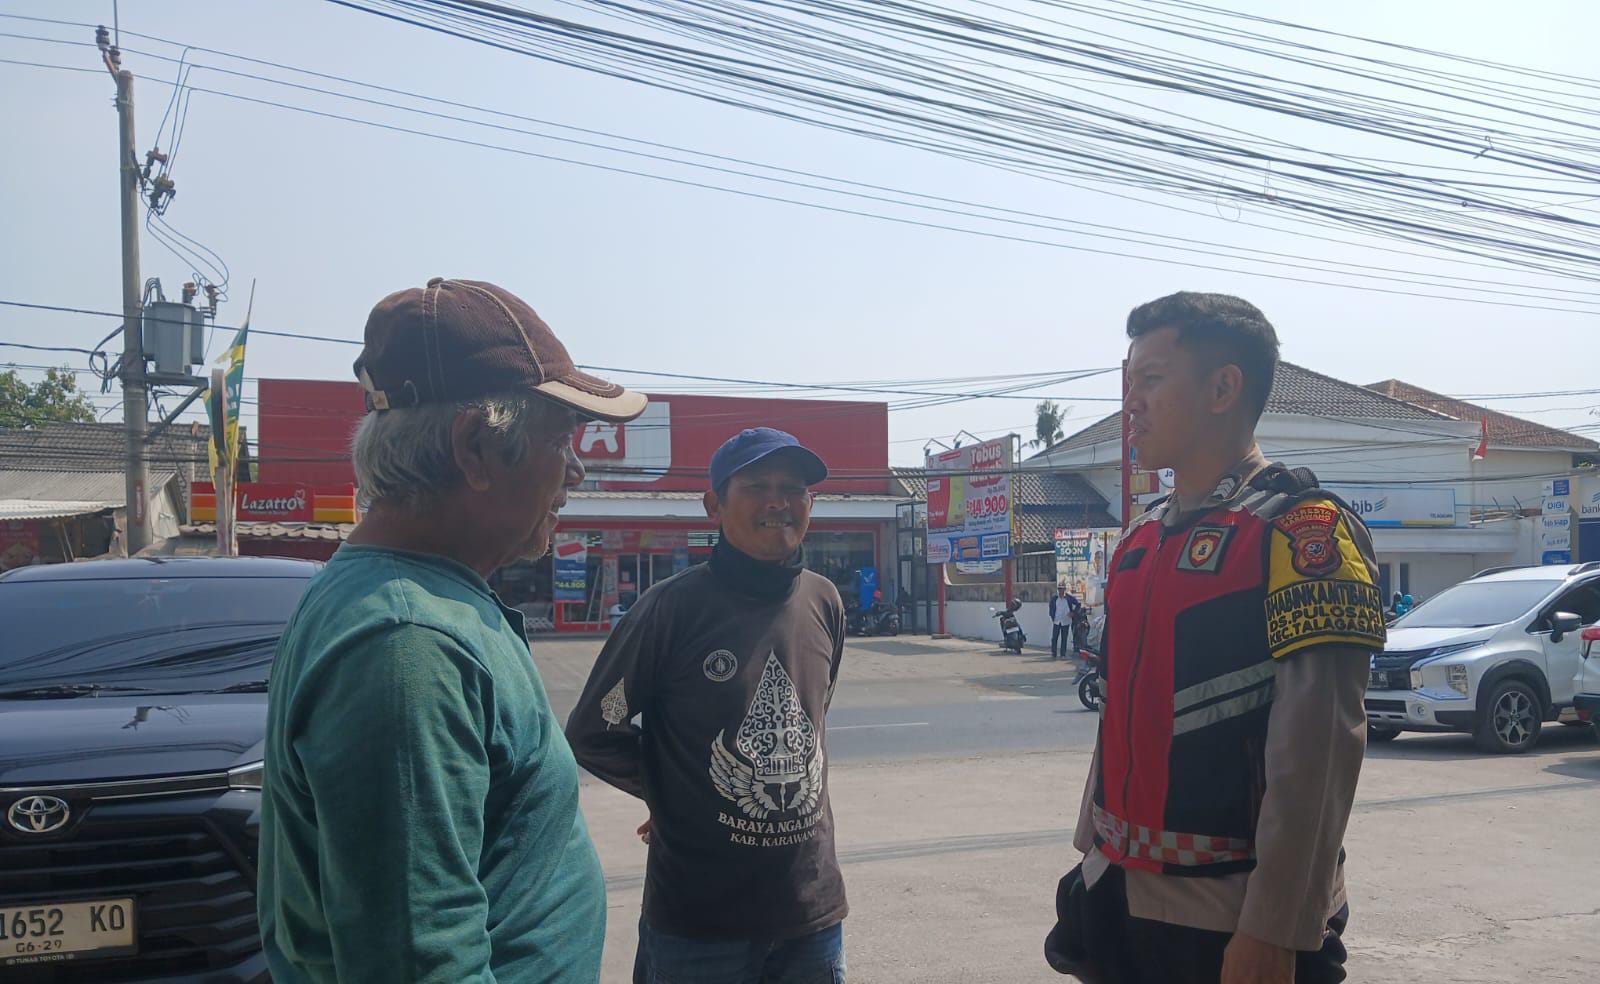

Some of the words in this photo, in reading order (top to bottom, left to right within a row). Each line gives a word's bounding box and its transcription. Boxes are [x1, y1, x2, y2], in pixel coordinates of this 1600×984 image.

[1352, 500, 1373, 514] bjb
[1056, 540, 1088, 548] COMING
[1060, 547, 1083, 556] SOON
[718, 811, 775, 833] BARAYA
[730, 832, 759, 846] KAB.
[762, 829, 817, 846] KARAWANG
[0, 909, 64, 939] 1652
